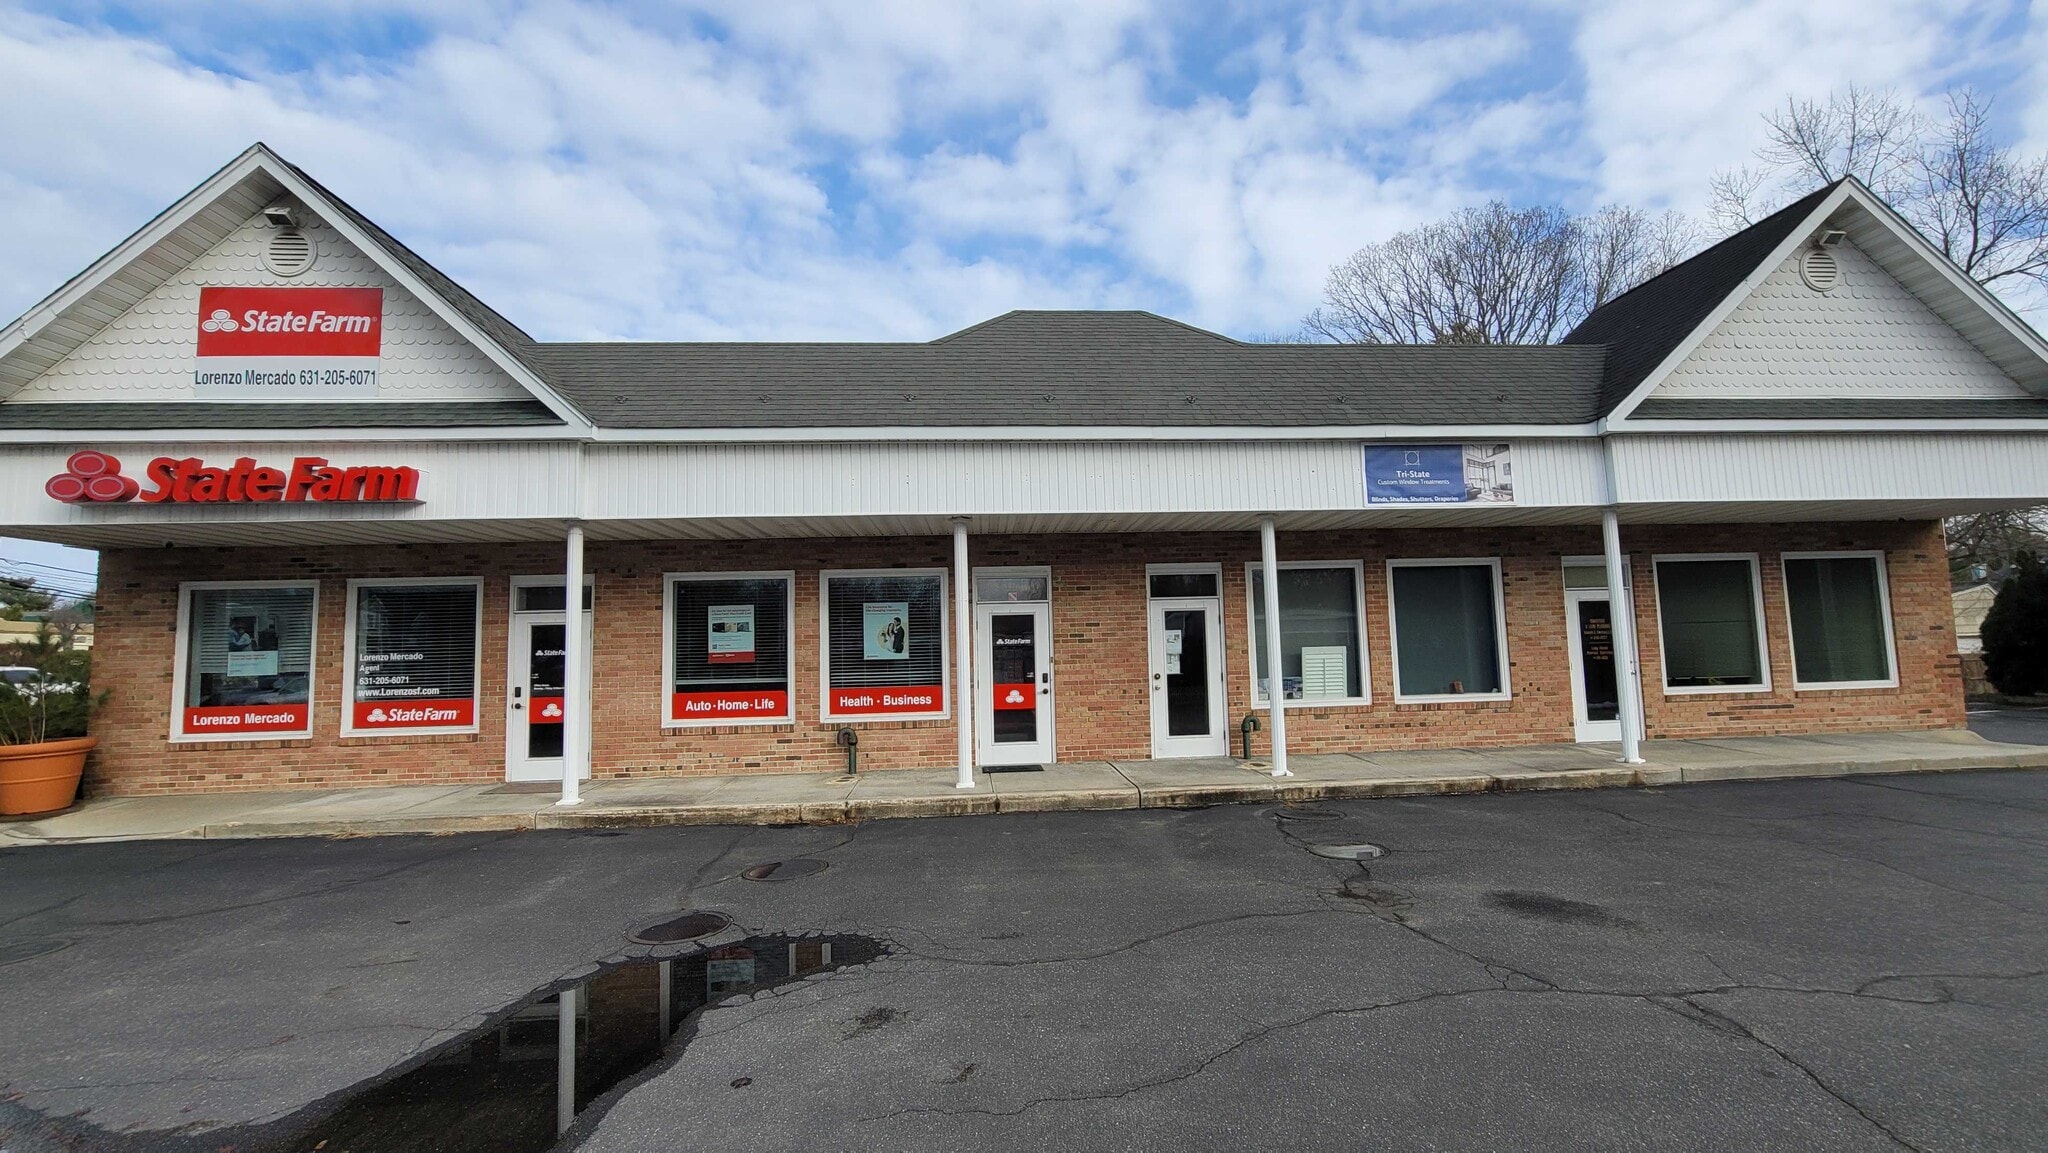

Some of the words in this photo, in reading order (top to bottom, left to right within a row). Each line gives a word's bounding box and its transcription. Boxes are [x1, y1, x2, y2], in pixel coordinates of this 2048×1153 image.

[195, 370, 242, 385] Lorenzo
[245, 370, 296, 385] Mercado
[300, 370, 376, 385] 631-205-6071
[1396, 470, 1430, 478] Tri-State
[360, 653, 389, 662] Lorenzo
[390, 652, 424, 661] Mercado
[359, 664, 380, 675] Agent
[359, 676, 409, 685] 631-205-6071
[358, 687, 440, 697] www.Lorenzosf.com
[685, 700, 712, 711] Auto
[717, 700, 749, 711] Home
[754, 699, 775, 710] Life
[839, 695, 874, 707] Health
[882, 694, 932, 706] Business
[193, 714, 240, 726] Lorenzo
[244, 712, 295, 724] Mercado
